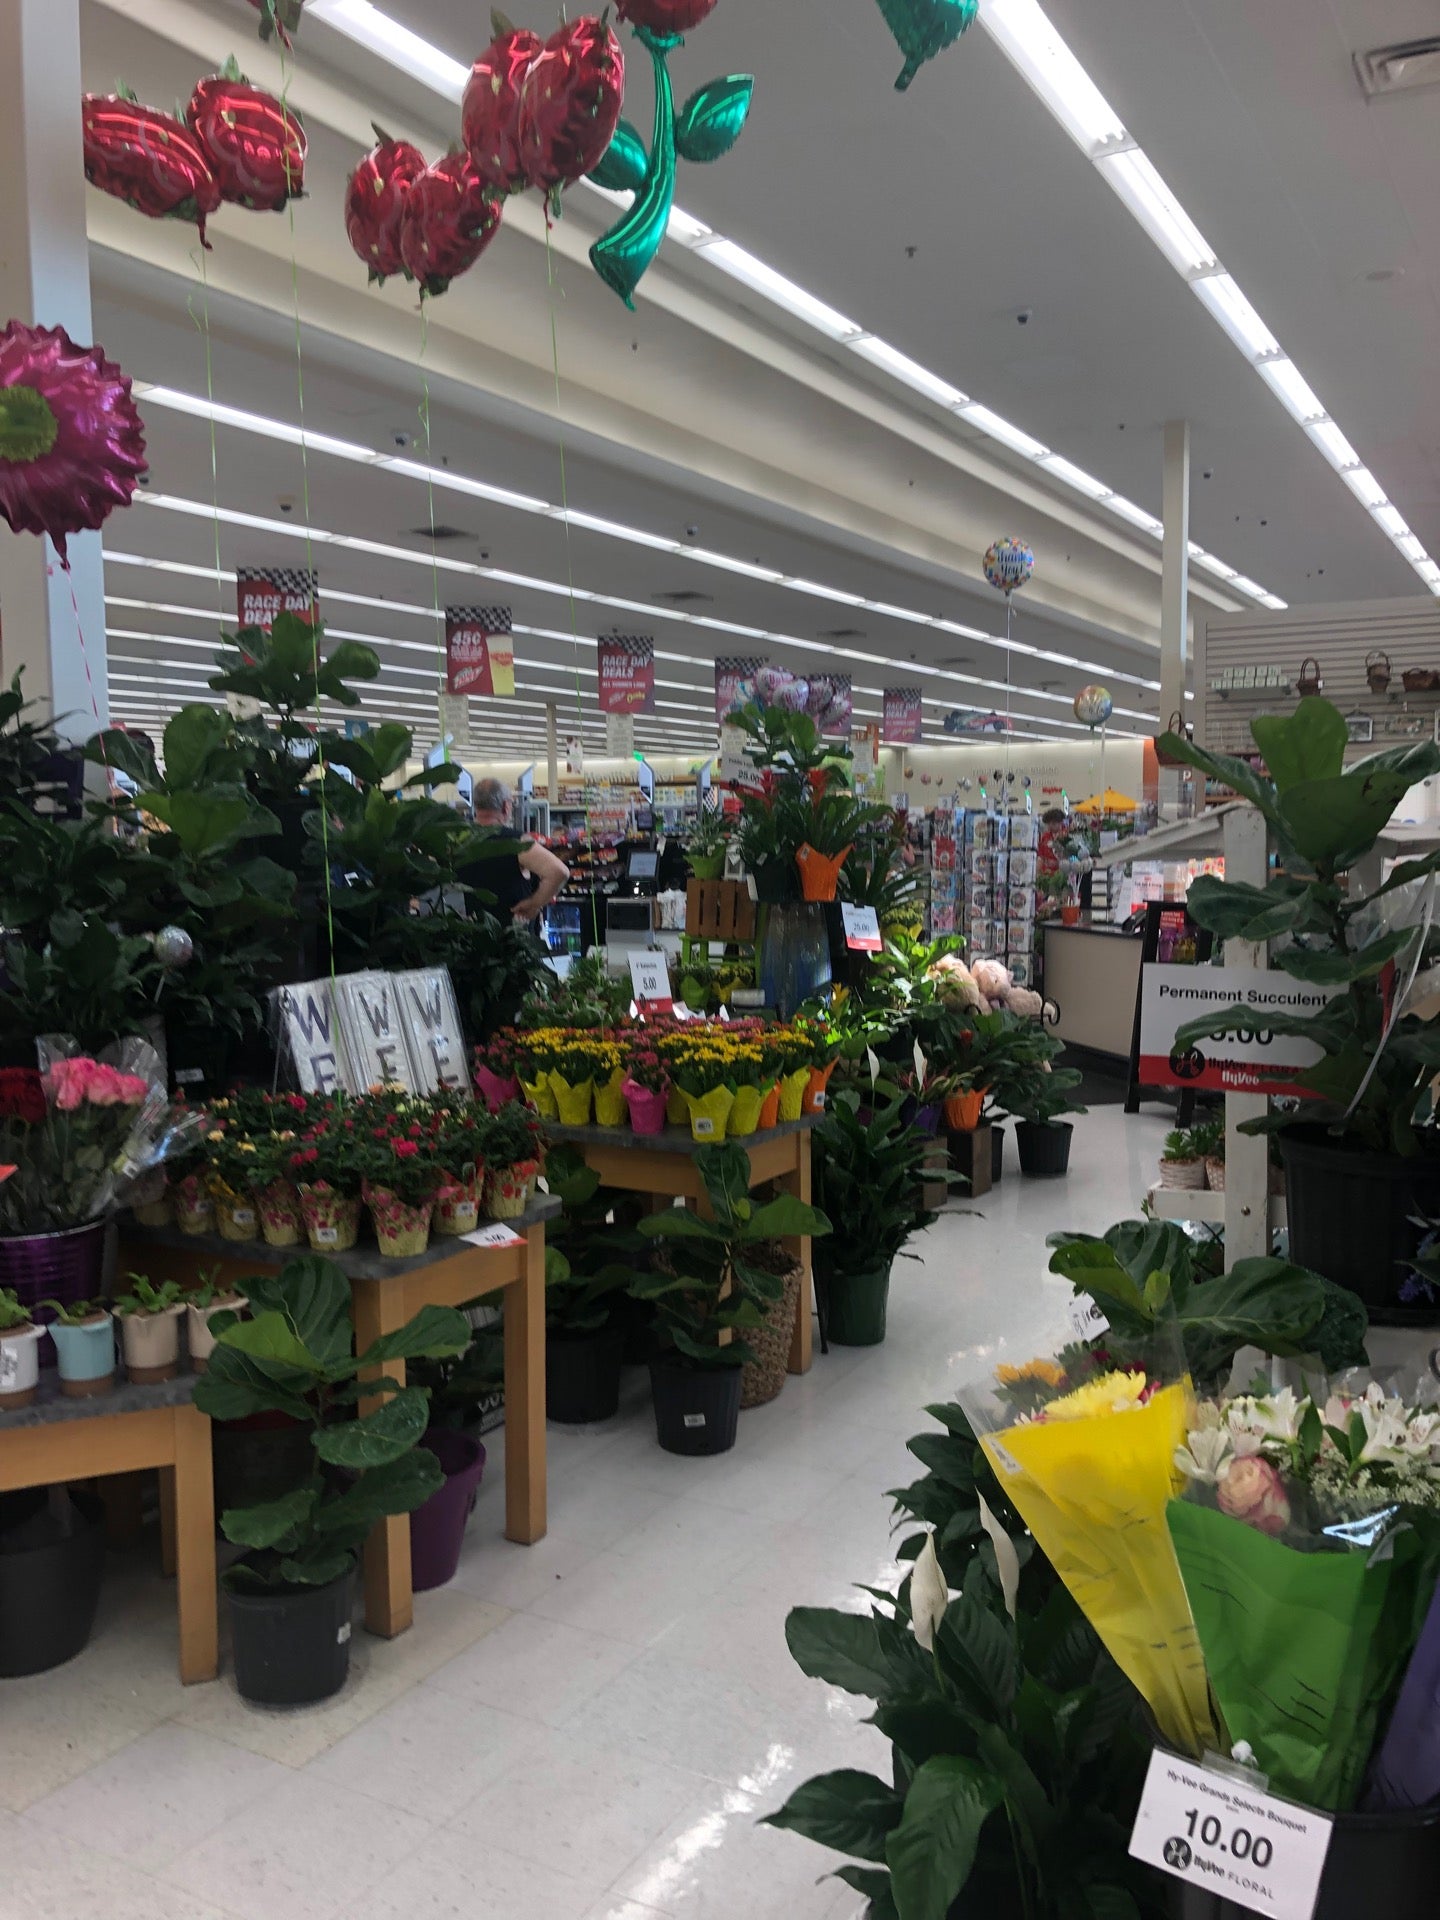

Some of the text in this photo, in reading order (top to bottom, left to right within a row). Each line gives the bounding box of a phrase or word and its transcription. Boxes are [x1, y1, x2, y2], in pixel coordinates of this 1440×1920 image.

[244, 594, 312, 611] RACE DAY
[243, 610, 278, 625] DEA
[602, 655, 650, 669] RACE DAY
[602, 667, 634, 679] DEALS
[1159, 984, 1243, 1002] Permanent
[1222, 1070, 1260, 1086] HyVee
[1167, 1768, 1197, 1790] Hy-Vee
[1232, 1795, 1265, 1817] Selects
[1267, 1809, 1307, 1834] Bouquet
[1185, 1808, 1273, 1868] 10.00
[1227, 1871, 1275, 1899] FLORAL
